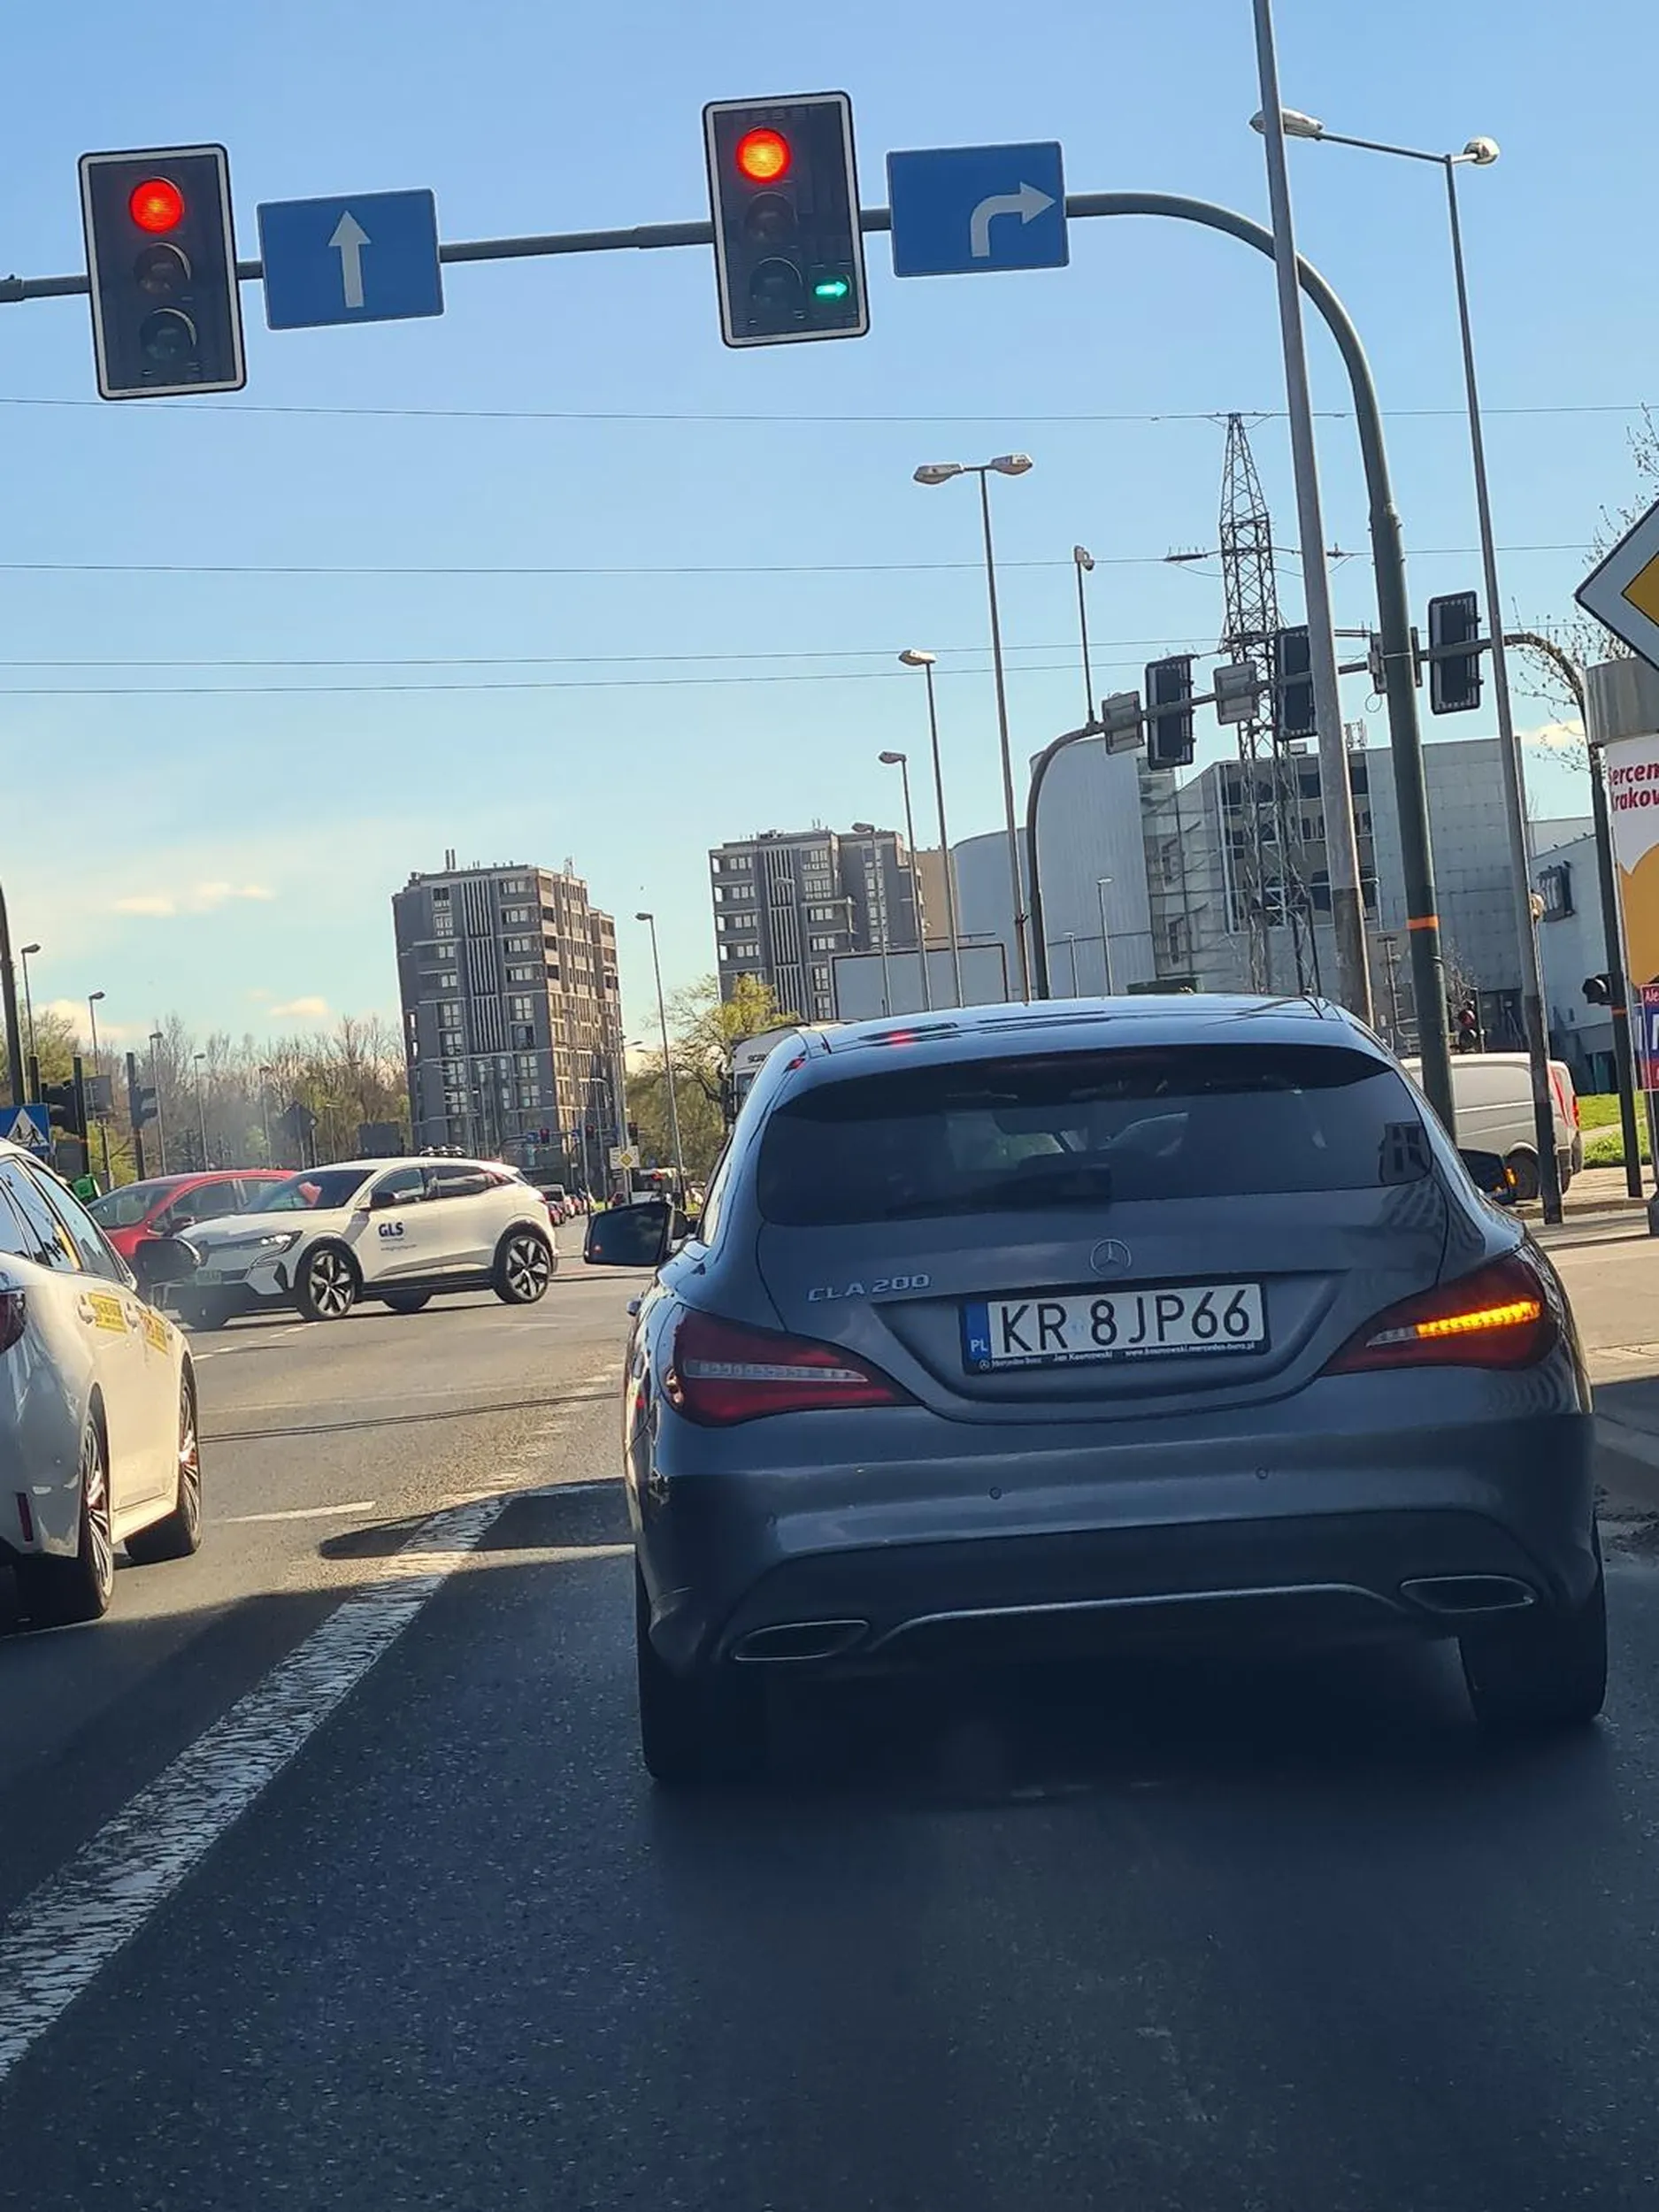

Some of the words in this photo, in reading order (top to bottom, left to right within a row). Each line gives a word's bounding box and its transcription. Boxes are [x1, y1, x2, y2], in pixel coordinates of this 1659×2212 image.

[379, 1222, 403, 1237] GLS
[808, 1283, 865, 1302] CLA
[872, 1274, 930, 1293] 200
[1001, 1302, 1069, 1353] KR
[1089, 1290, 1249, 1346] 8JP66
[970, 1339, 988, 1352] PL
